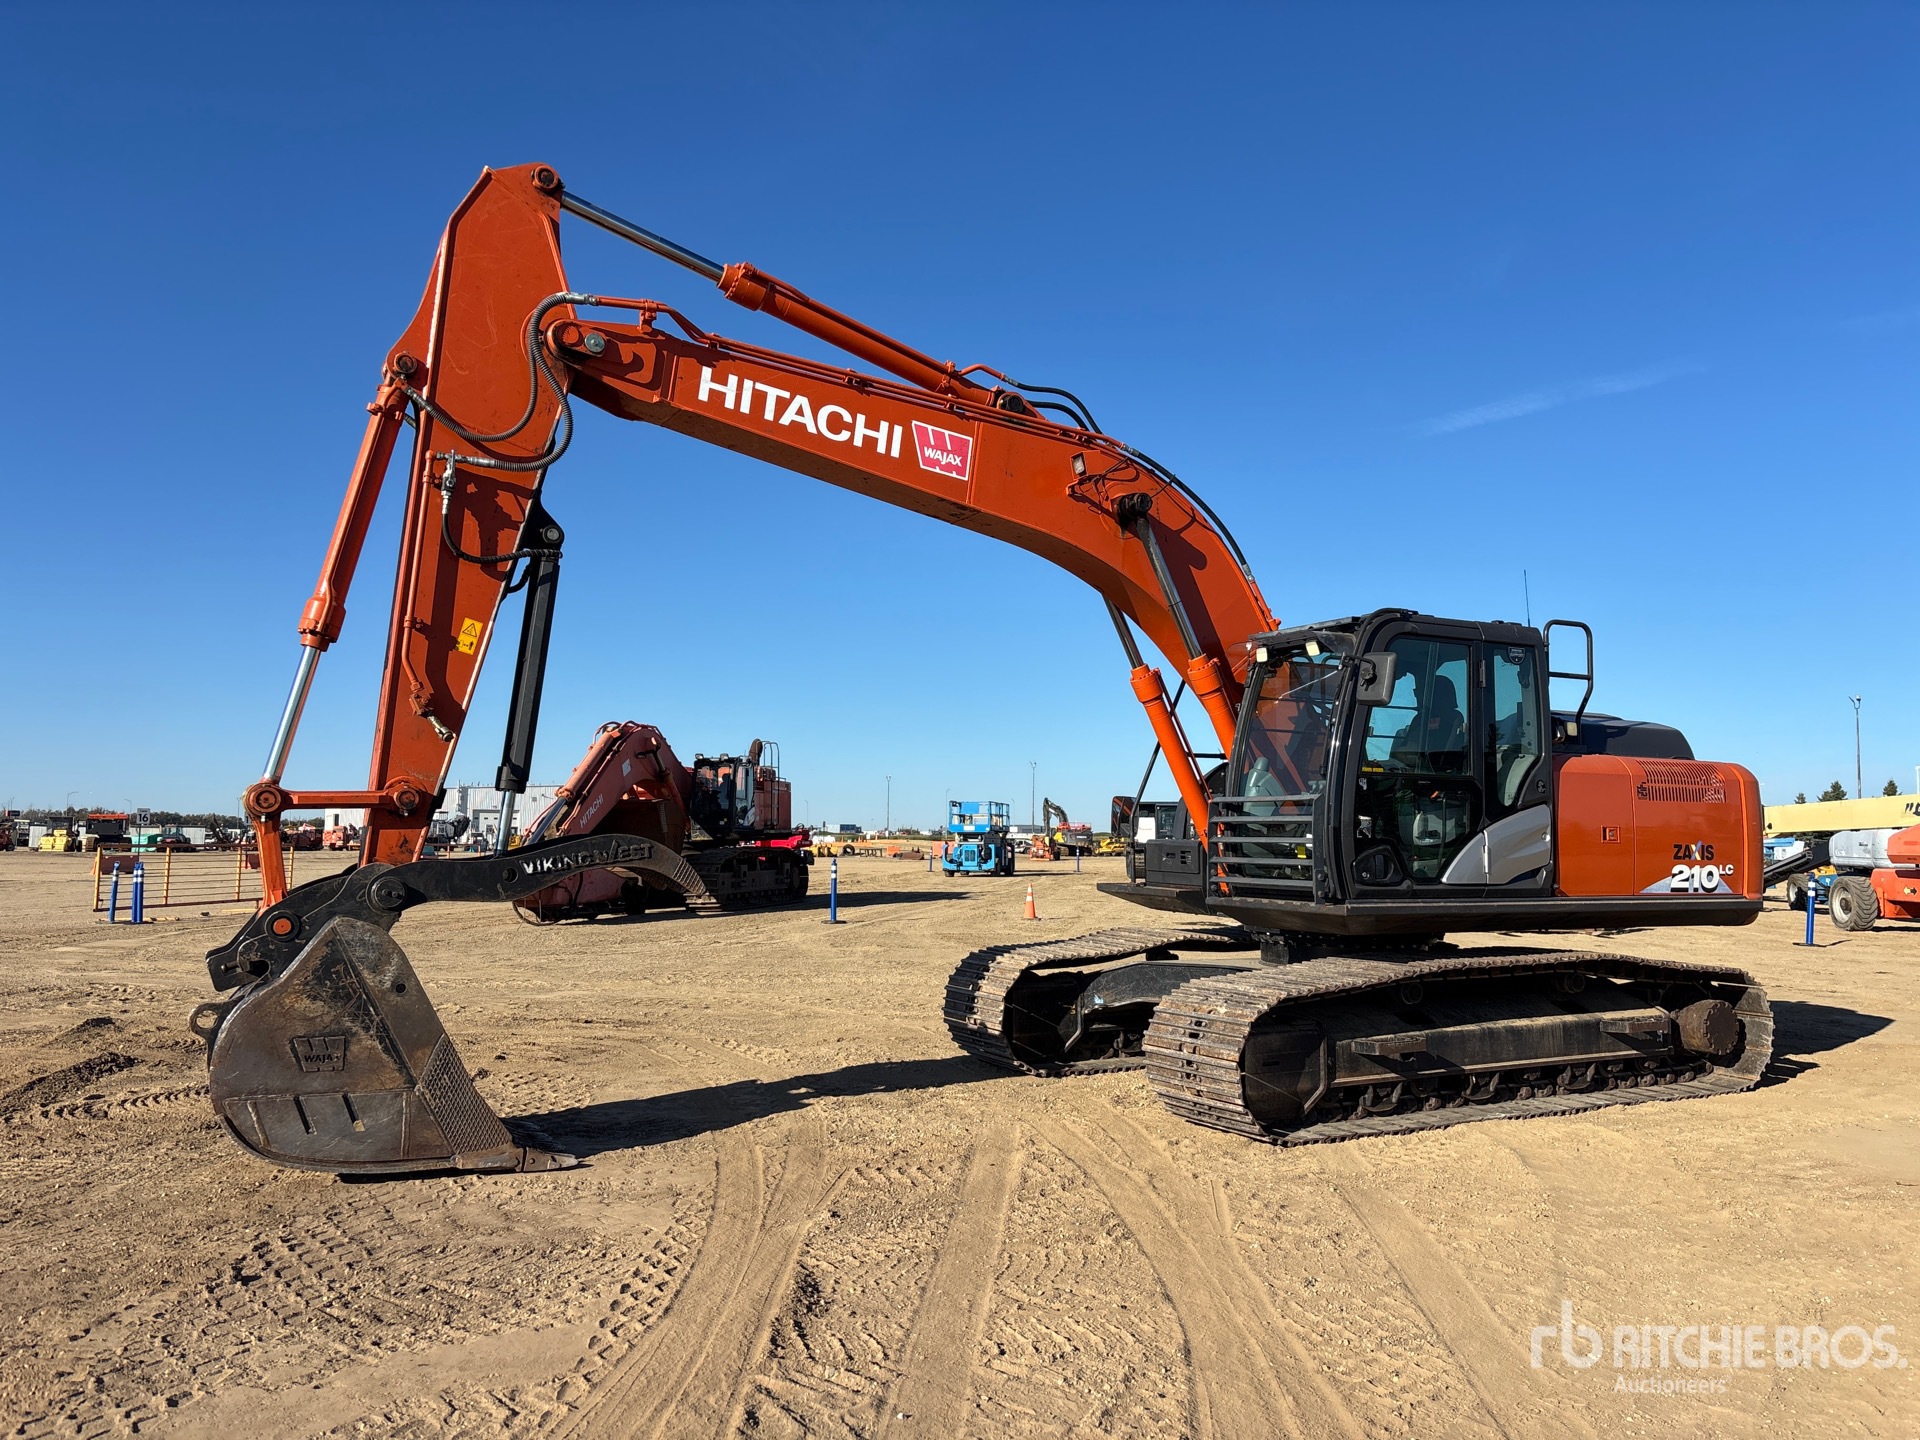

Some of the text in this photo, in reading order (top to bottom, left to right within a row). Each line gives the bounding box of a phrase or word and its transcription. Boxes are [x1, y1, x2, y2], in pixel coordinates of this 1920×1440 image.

[698, 366, 903, 459] HITACHI
[923, 445, 963, 468] WAJAX
[138, 813, 149, 823] 16
[580, 793, 604, 829] HITACHI
[1673, 840, 1715, 861] ZAXIS
[304, 1053, 341, 1064] WAJAX
